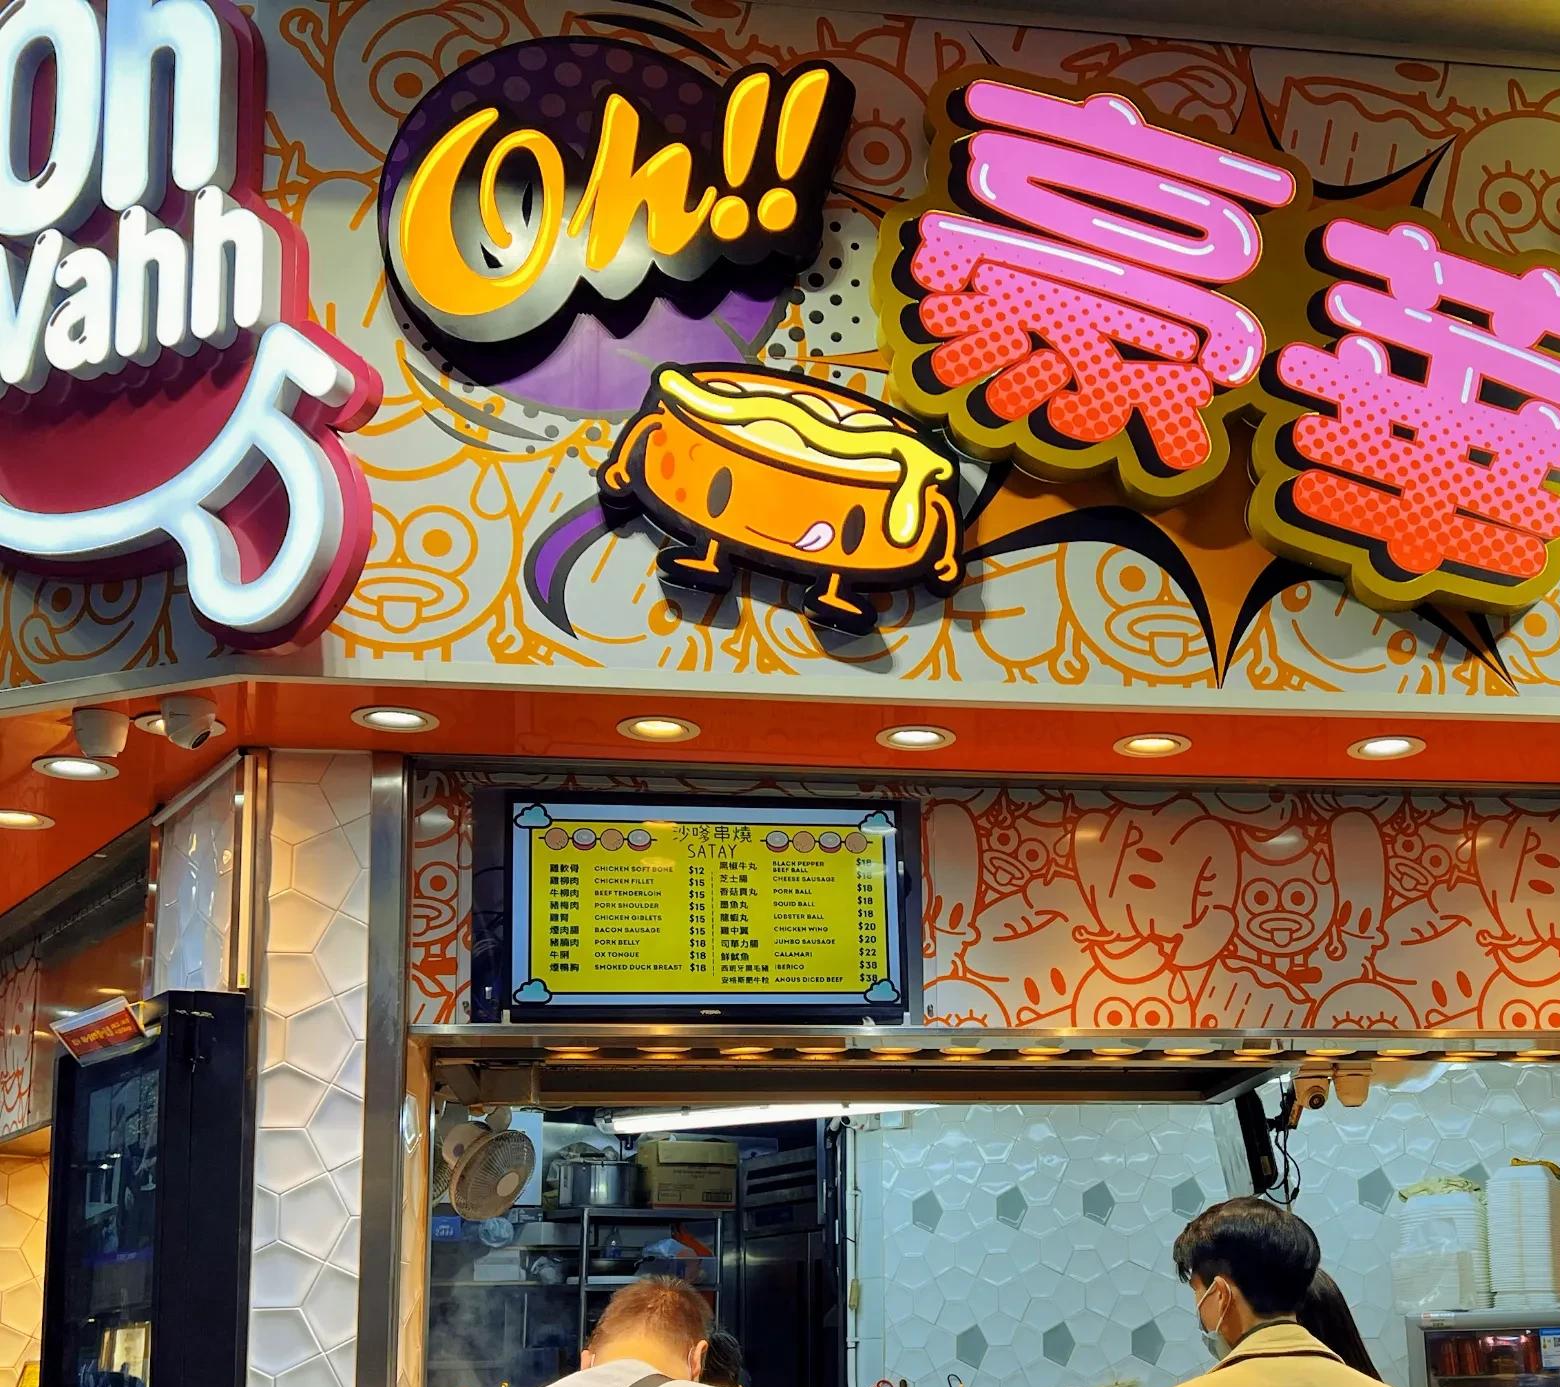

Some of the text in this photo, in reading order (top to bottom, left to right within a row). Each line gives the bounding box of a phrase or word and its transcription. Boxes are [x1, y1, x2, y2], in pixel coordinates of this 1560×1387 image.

[399, 68, 829, 315] Oh!!
[672, 824, 752, 844] 沙嗲串燒
[688, 843, 737, 859] SATAY
[689, 866, 704, 875] $12
[689, 878, 704, 886] $15
[857, 884, 872, 892] $18
[689, 890, 704, 898] $15
[858, 897, 873, 905] $18
[689, 902, 705, 910] $15
[858, 909, 873, 918] $18
[689, 914, 705, 923] $15
[859, 922, 876, 931] $20
[689, 927, 705, 935] $15
[690, 939, 706, 947] $18
[859, 935, 876, 944] $20
[690, 951, 706, 959] $18
[859, 949, 877, 957] $22
[859, 961, 877, 969] $38
[860, 974, 877, 982] $38
